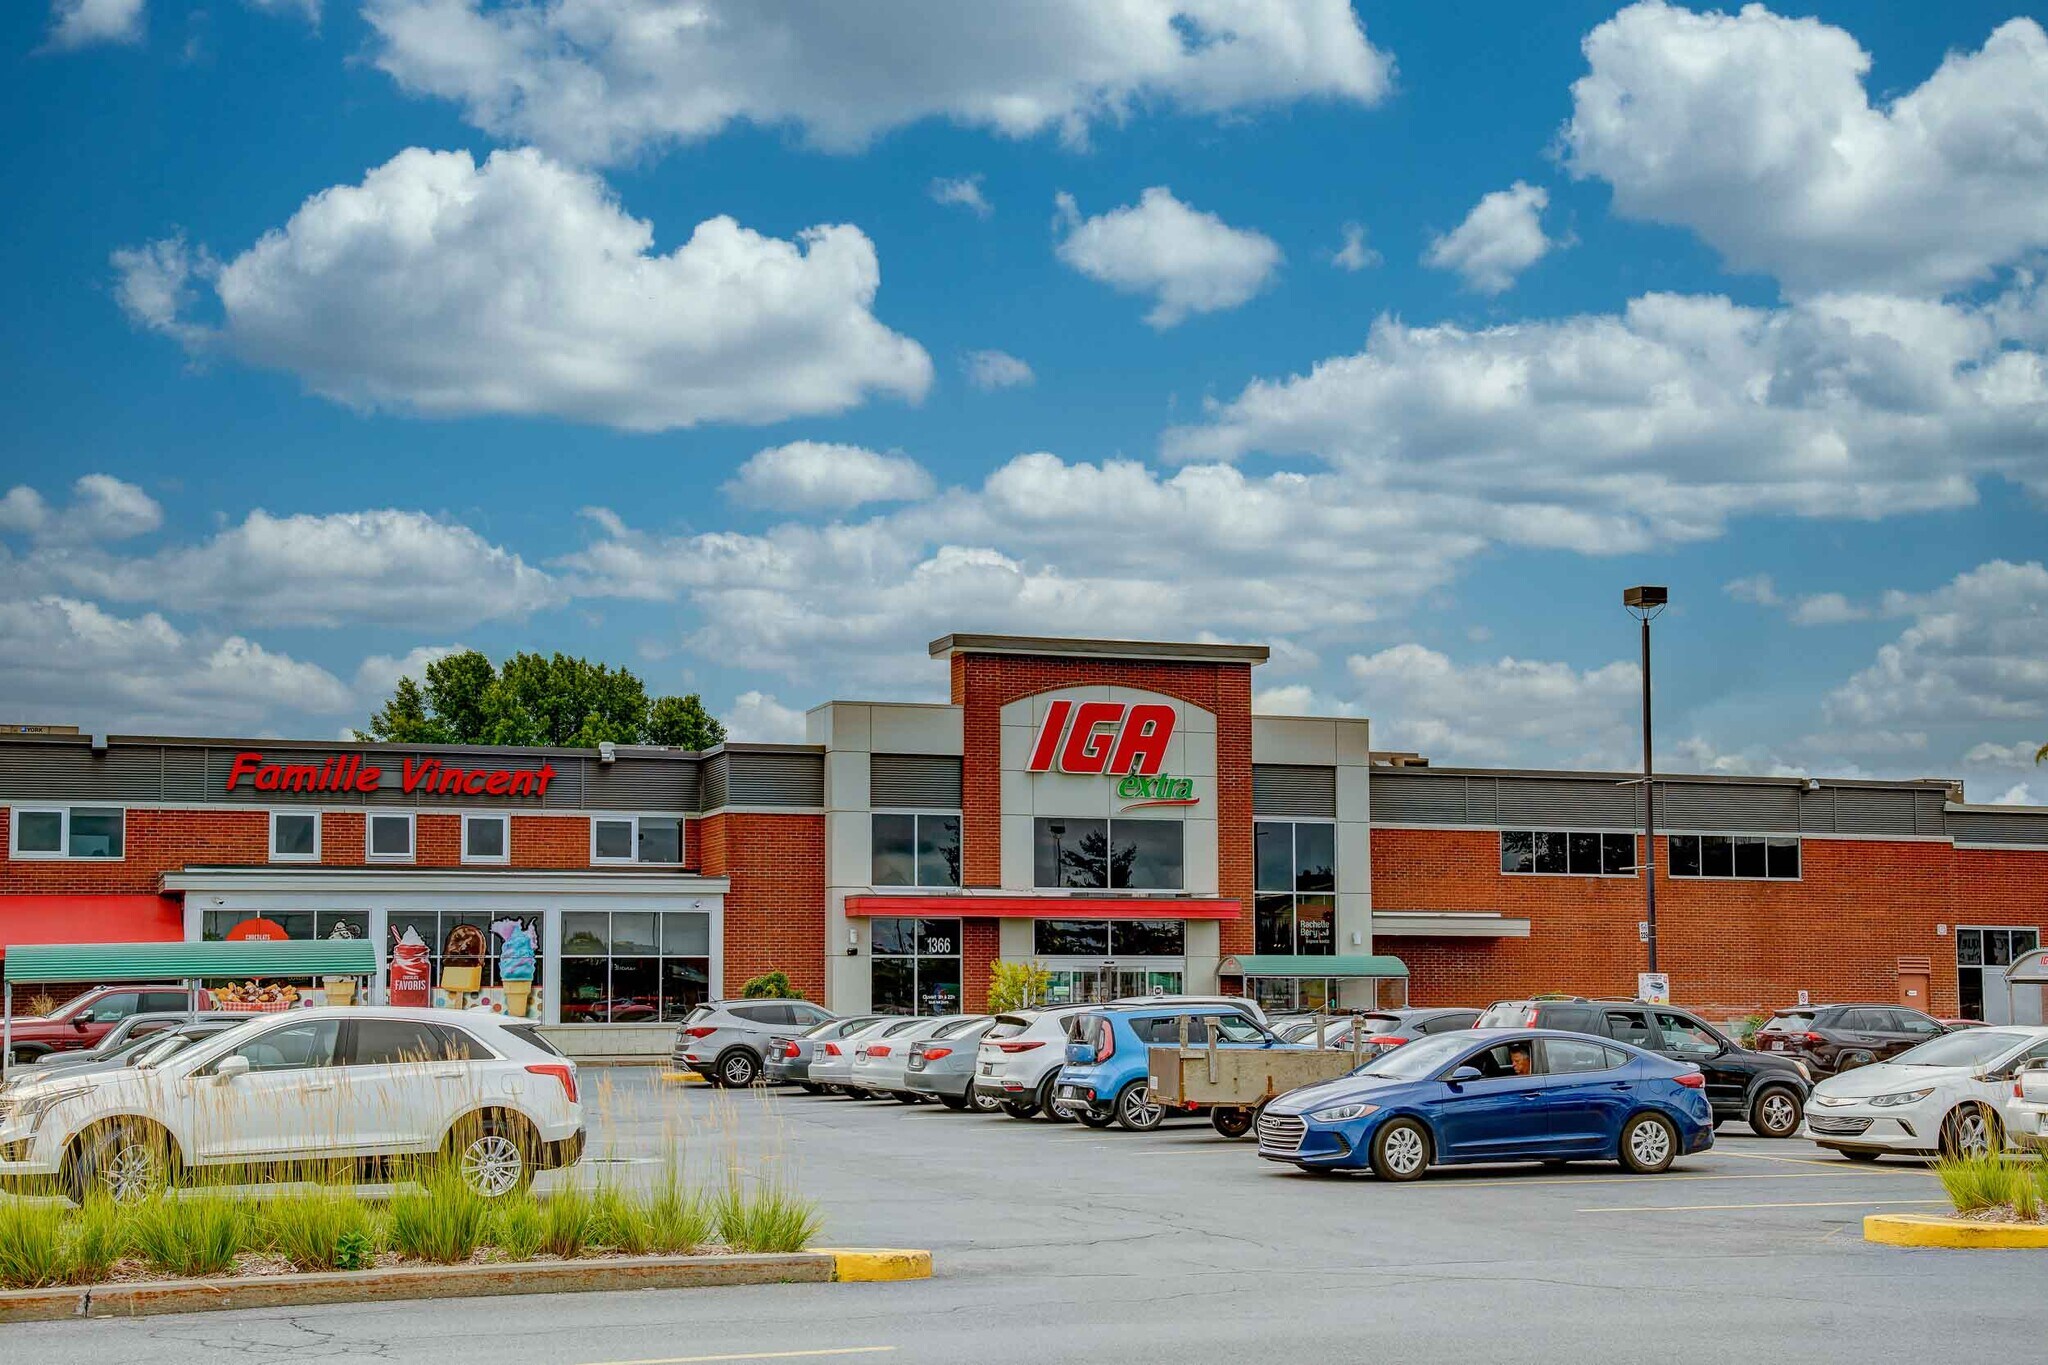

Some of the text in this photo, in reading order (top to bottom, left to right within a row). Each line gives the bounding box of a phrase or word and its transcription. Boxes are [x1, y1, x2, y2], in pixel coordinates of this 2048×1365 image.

[1026, 700, 1177, 776] IGA
[226, 752, 558, 797] Famille Vincent
[1117, 772, 1194, 799] extra
[1300, 920, 1330, 929] Rachelle
[927, 936, 951, 953] 1366
[394, 980, 426, 991] FAVORIS
